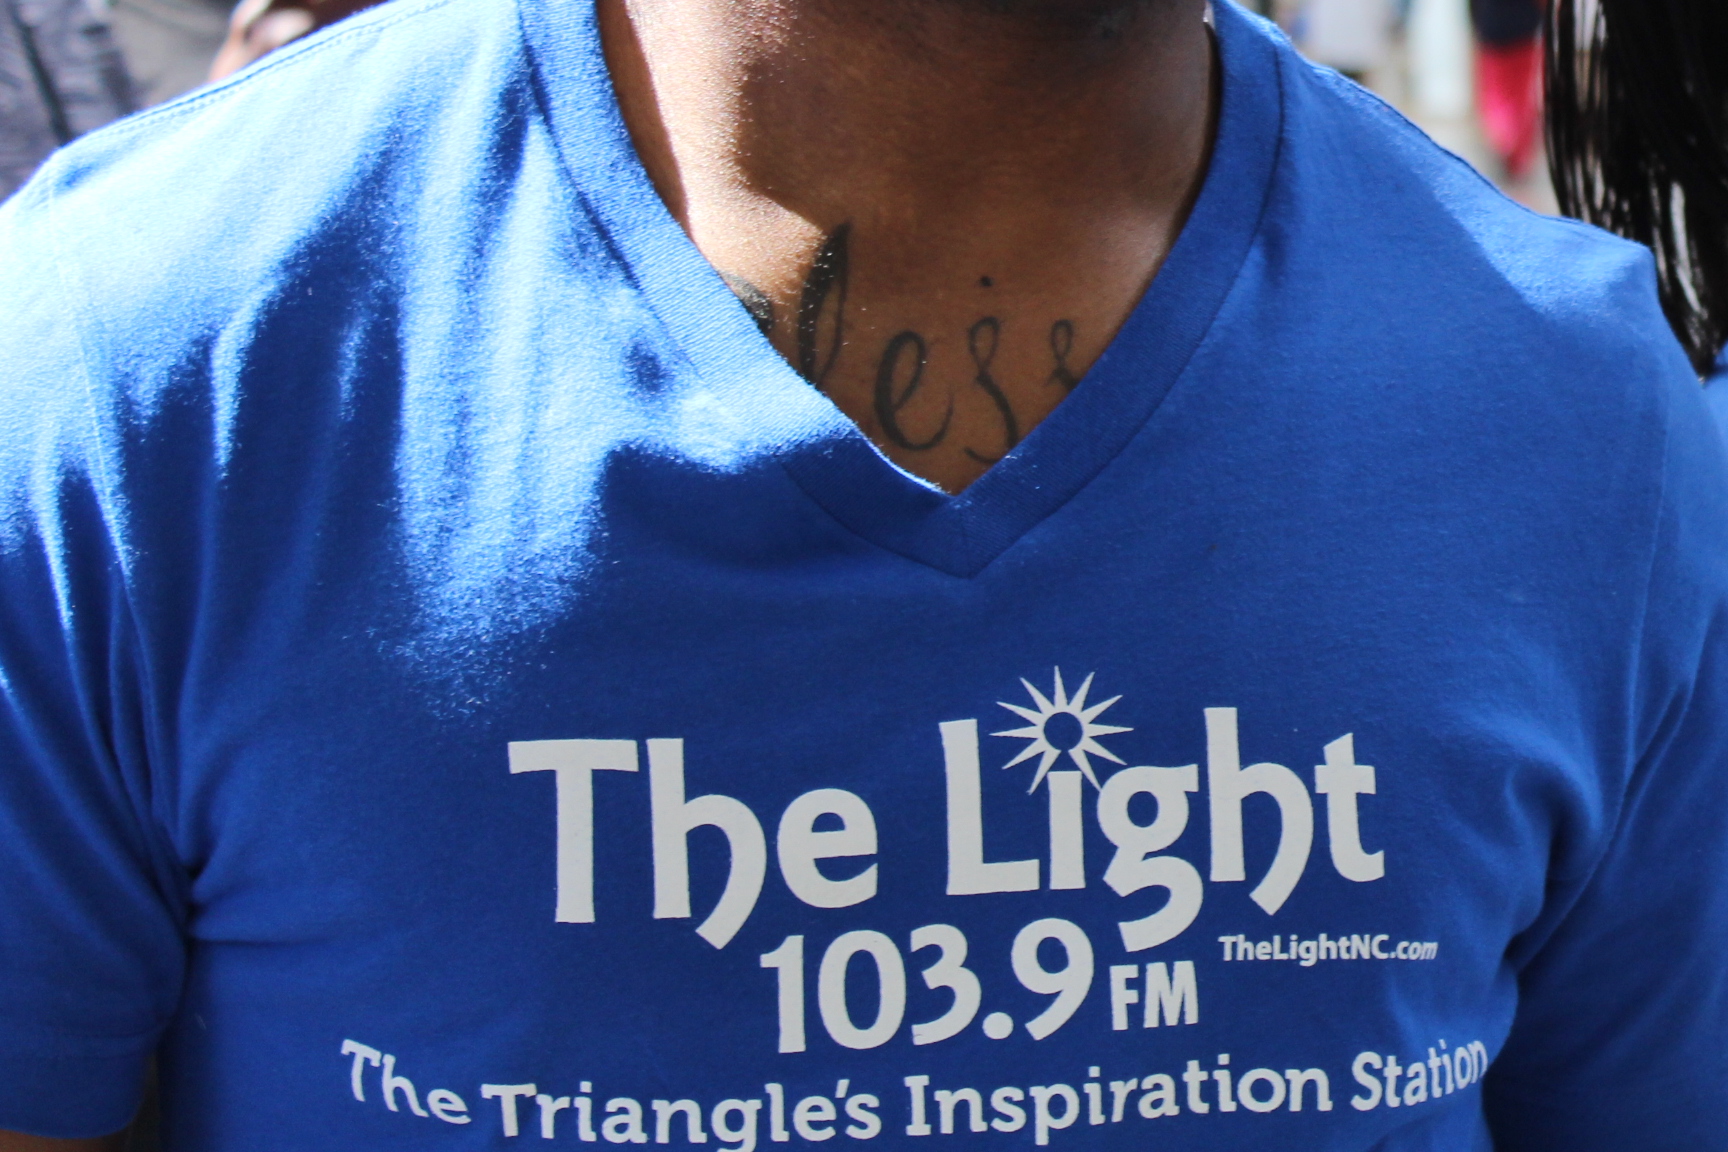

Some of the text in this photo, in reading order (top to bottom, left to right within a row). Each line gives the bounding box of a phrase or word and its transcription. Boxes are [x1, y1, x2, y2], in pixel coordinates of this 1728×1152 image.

[508, 667, 1385, 953] The Light
[759, 918, 1200, 1054] 103.9 FM
[1217, 933, 1439, 967] TheLightNC.com
[340, 1038, 1489, 1152] The Triangle's Inspiration Station
